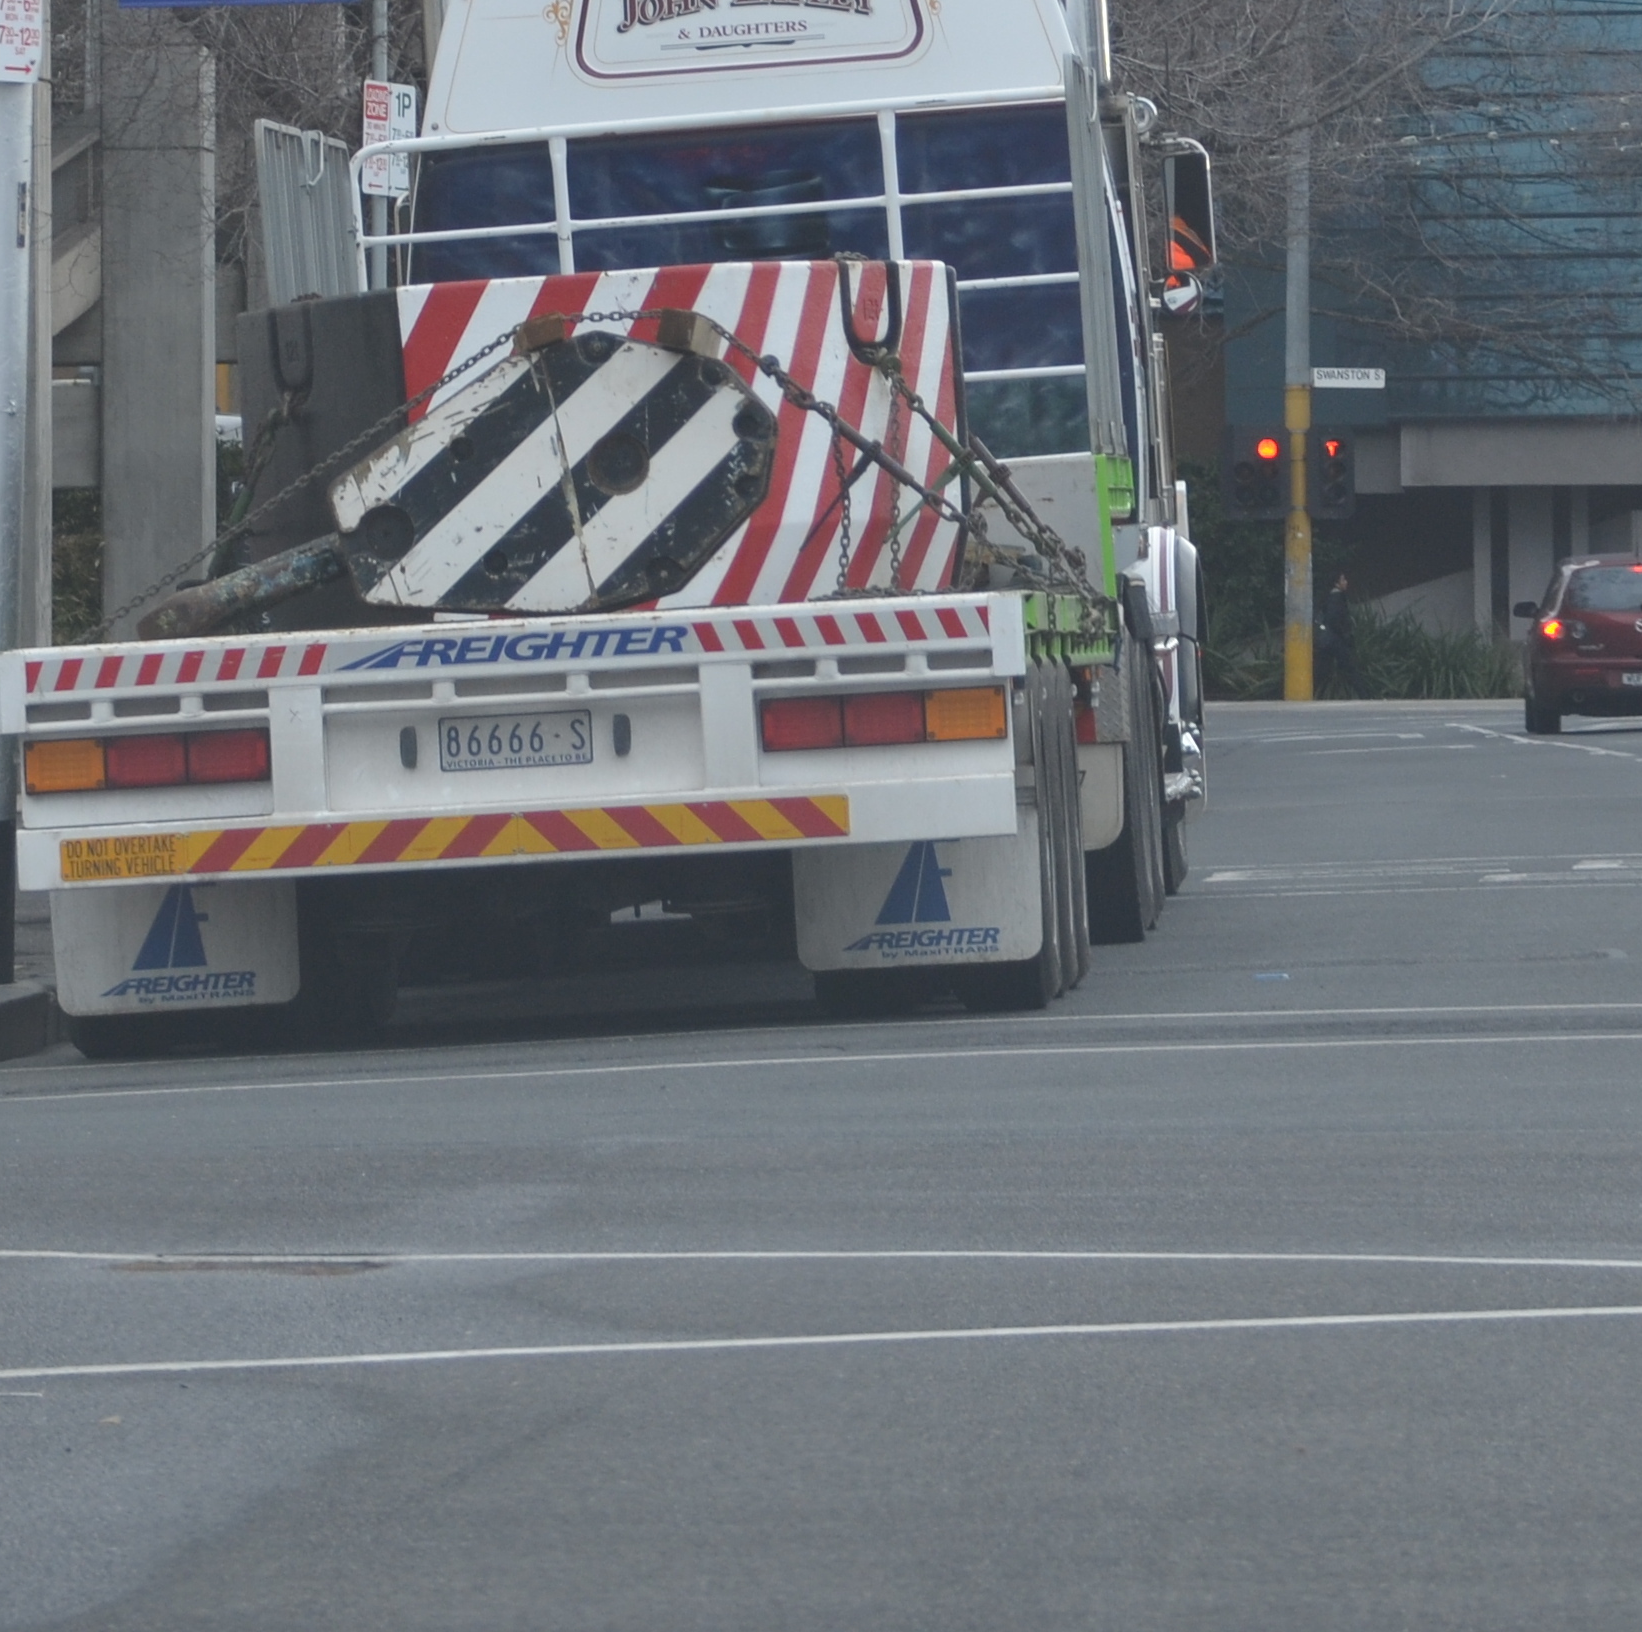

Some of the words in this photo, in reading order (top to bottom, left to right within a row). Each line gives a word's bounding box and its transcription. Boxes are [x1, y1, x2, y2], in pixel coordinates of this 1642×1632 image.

[677, 28, 691, 40] &
[699, 20, 808, 39] DAUGHTERS
[367, 102, 388, 117] ZONE
[395, 92, 412, 118] 1P
[1316, 369, 1370, 380] SWANSTON
[338, 626, 689, 670] FREIGHTER
[446, 760, 495, 769] VICTORIA
[504, 757, 522, 765] THE
[525, 755, 556, 764] PLACE
[560, 754, 573, 762] TO
[576, 753, 588, 761] BE
[66, 841, 83, 859] DO
[86, 839, 109, 857] NOT
[114, 834, 176, 856] OVERTAKE
[69, 858, 121, 878] TURNING
[125, 854, 176, 875] VEHICLE
[842, 927, 1000, 951] FREIGHTER
[881, 951, 898, 959] by
[100, 971, 257, 997] FREIGHTER
[138, 997, 155, 1005] by
